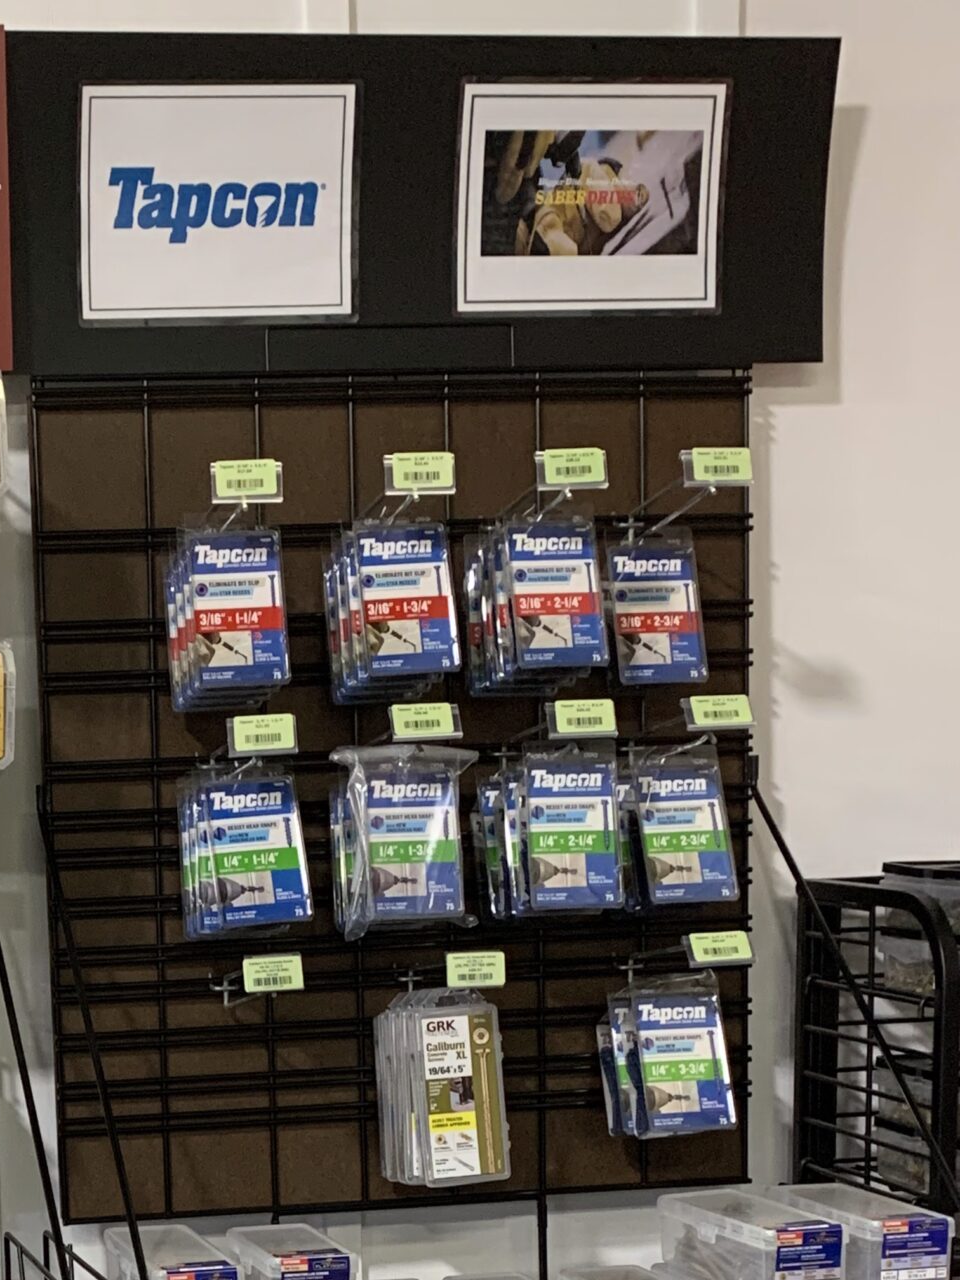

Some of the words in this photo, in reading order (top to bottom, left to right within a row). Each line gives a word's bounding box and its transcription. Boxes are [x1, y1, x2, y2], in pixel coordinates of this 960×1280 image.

[108, 167, 317, 244] Tapcon
[360, 538, 432, 559] Tapcon
[512, 534, 583, 554] Tapcon
[194, 545, 268, 564] Tapcon
[613, 556, 682, 576] Tapcon
[368, 602, 393, 615] 3/16"
[404, 600, 432, 612] 1-3/4"
[520, 597, 544, 610] 3/16"
[554, 596, 582, 609] 2-1/4"
[200, 613, 226, 626] 3/16"
[236, 611, 263, 624] 1-1/4"
[620, 616, 644, 628] 3/16"
[654, 615, 684, 628] 2-3/4"
[531, 770, 602, 790] Tapcon
[639, 776, 706, 797] Tapcon
[371, 780, 442, 801] Tapcon
[210, 792, 282, 812] Tapcon
[540, 836, 558, 848] 1/4"
[568, 834, 596, 846] 2-1/4"
[653, 836, 670, 848] 1/4"
[680, 834, 710, 846] 2-3/4"
[224, 856, 242, 868] 1/4"
[253, 852, 279, 865] 1-1/4"
[639, 1004, 706, 1024] Tapcon
[426, 1019, 456, 1033] GRK
[426, 1042, 466, 1053] Caliburn
[456, 1050, 467, 1060] XL
[652, 1064, 669, 1075] 1/4"
[679, 1062, 709, 1074] 3-3/4"
